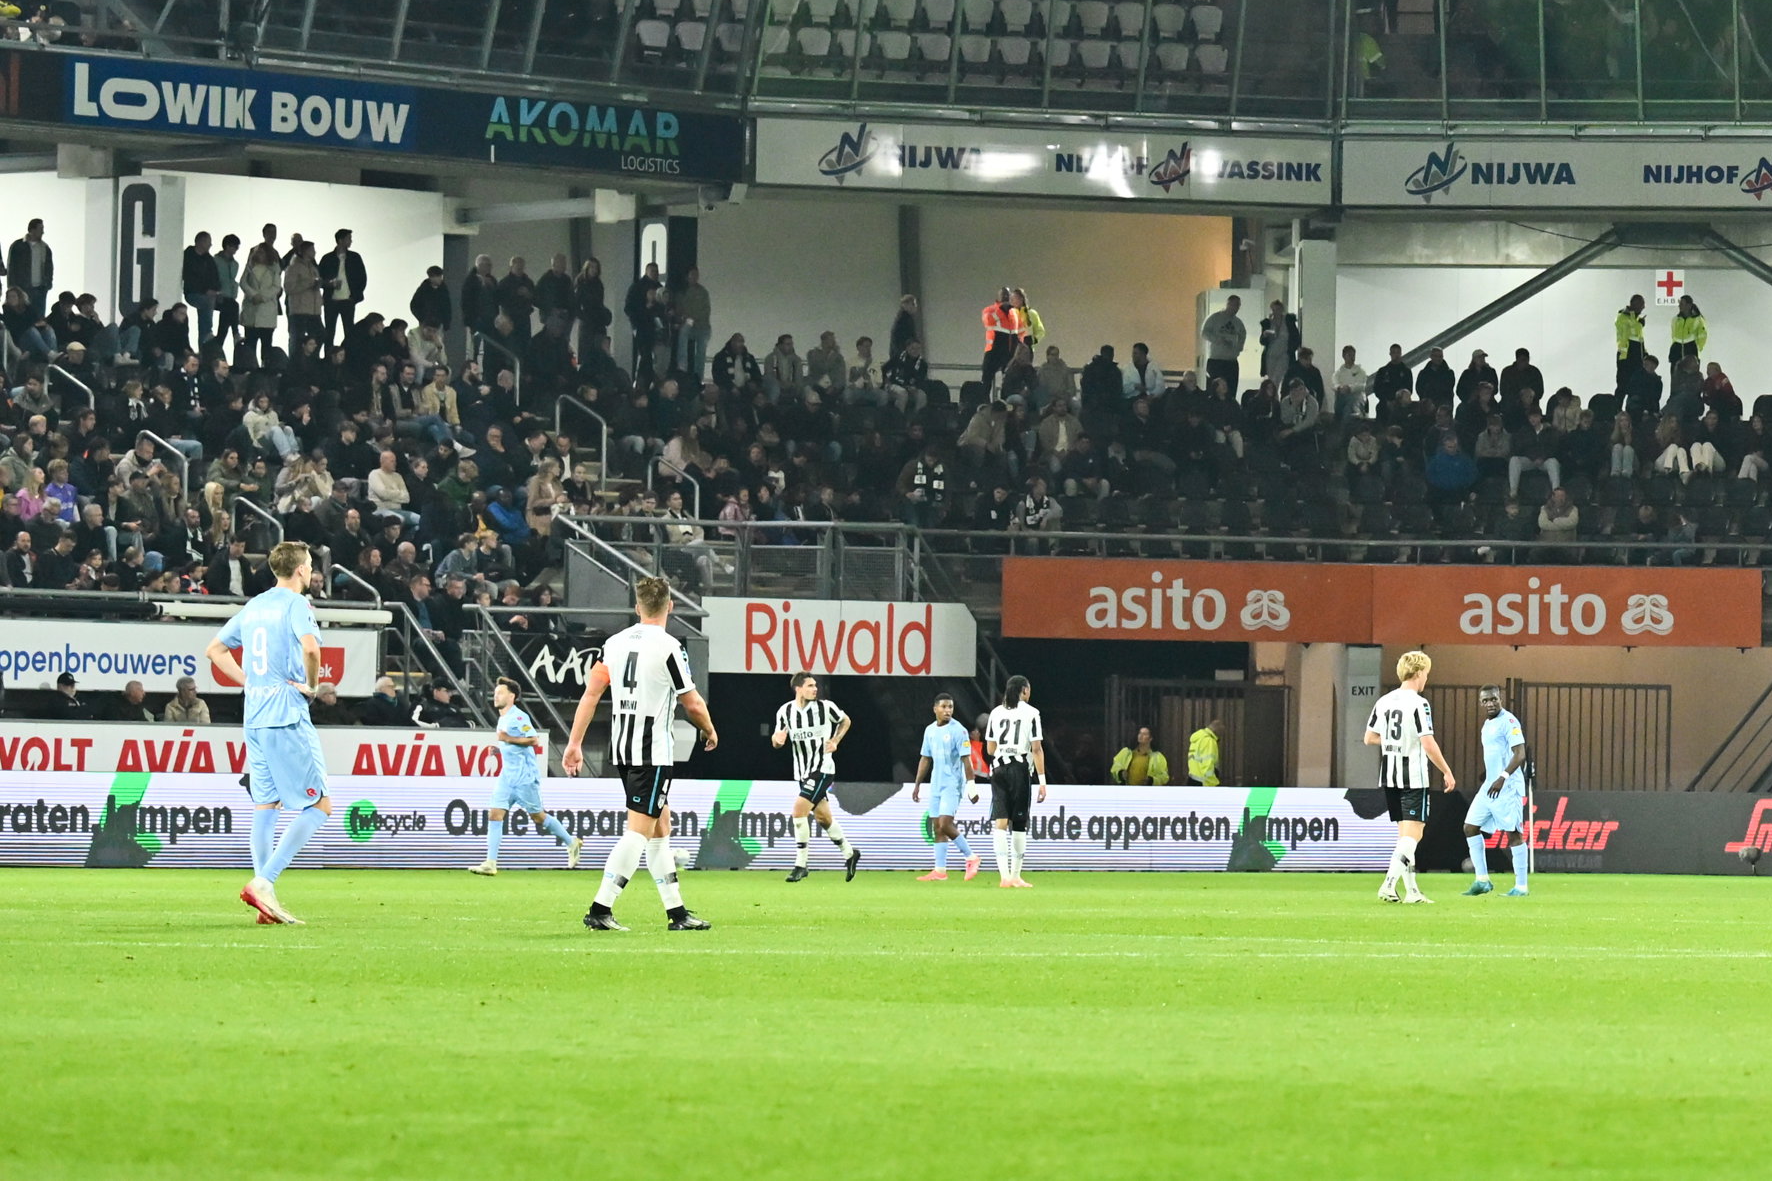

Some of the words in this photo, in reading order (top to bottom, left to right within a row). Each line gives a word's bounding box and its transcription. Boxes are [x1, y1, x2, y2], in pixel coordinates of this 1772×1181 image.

[74, 62, 256, 130] LOWIK
[271, 91, 410, 144] BOUW
[485, 96, 680, 156] AKOMAR
[621, 155, 680, 174] LOGISTICS
[1471, 162, 1576, 186] NIJWA
[1643, 164, 1740, 186] NIJHOF
[119, 183, 157, 319] G
[1085, 571, 1227, 631] asito
[1459, 577, 1607, 636] asito
[252, 626, 268, 675] 9
[745, 600, 933, 675] Riwald
[624, 651, 639, 694] 4
[1351, 686, 1375, 696] EXIT
[999, 719, 1021, 745] 21
[1384, 709, 1403, 741] 13
